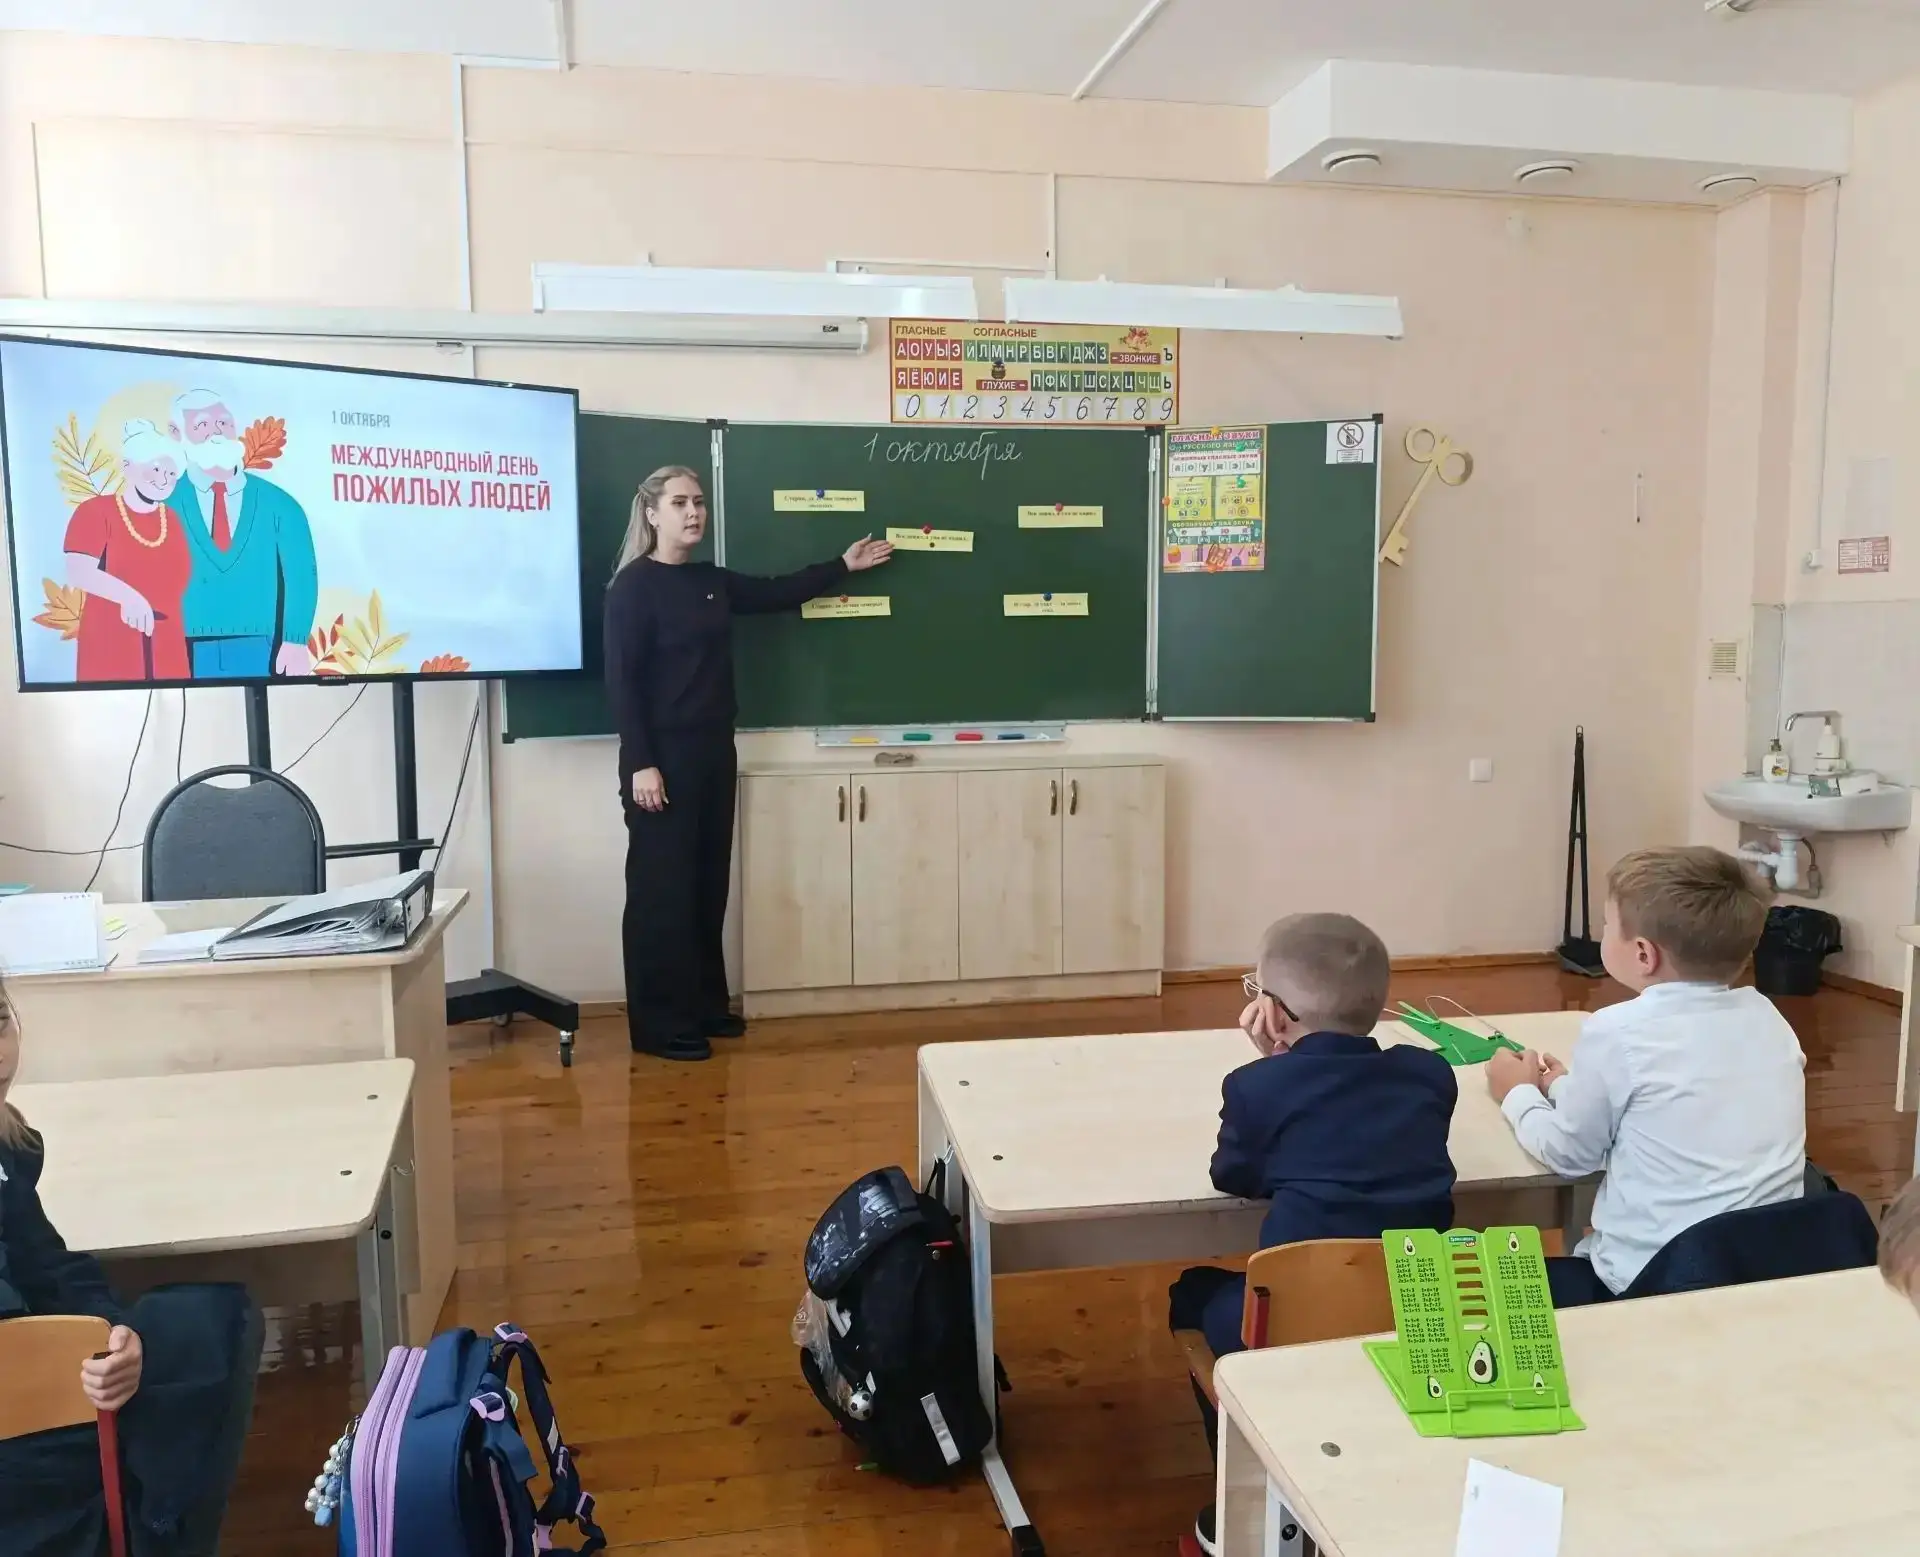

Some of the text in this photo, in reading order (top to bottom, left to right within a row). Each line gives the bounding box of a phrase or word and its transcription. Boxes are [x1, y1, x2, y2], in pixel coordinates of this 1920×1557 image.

[896, 325, 1037, 337] ГЛАСНЫЕ СОГЛАСНЫЕ
[1119, 354, 1158, 363] ЗВОНКИЕ
[982, 381, 1016, 389] ГЛУХИЕ
[906, 394, 1173, 420] 0 1 2 3 4 5 6 7 8 9
[331, 410, 390, 428] 1 ОКТЯБРЯ
[1224, 431, 1259, 440] ЗВУКИ
[331, 444, 538, 477] МЕЖДУНАРОДНЫЙ ДЕНЬ
[864, 431, 1023, 481] 1 октября
[333, 473, 551, 512] ПОЖИЛЫХ ЛЮДЕЙ
